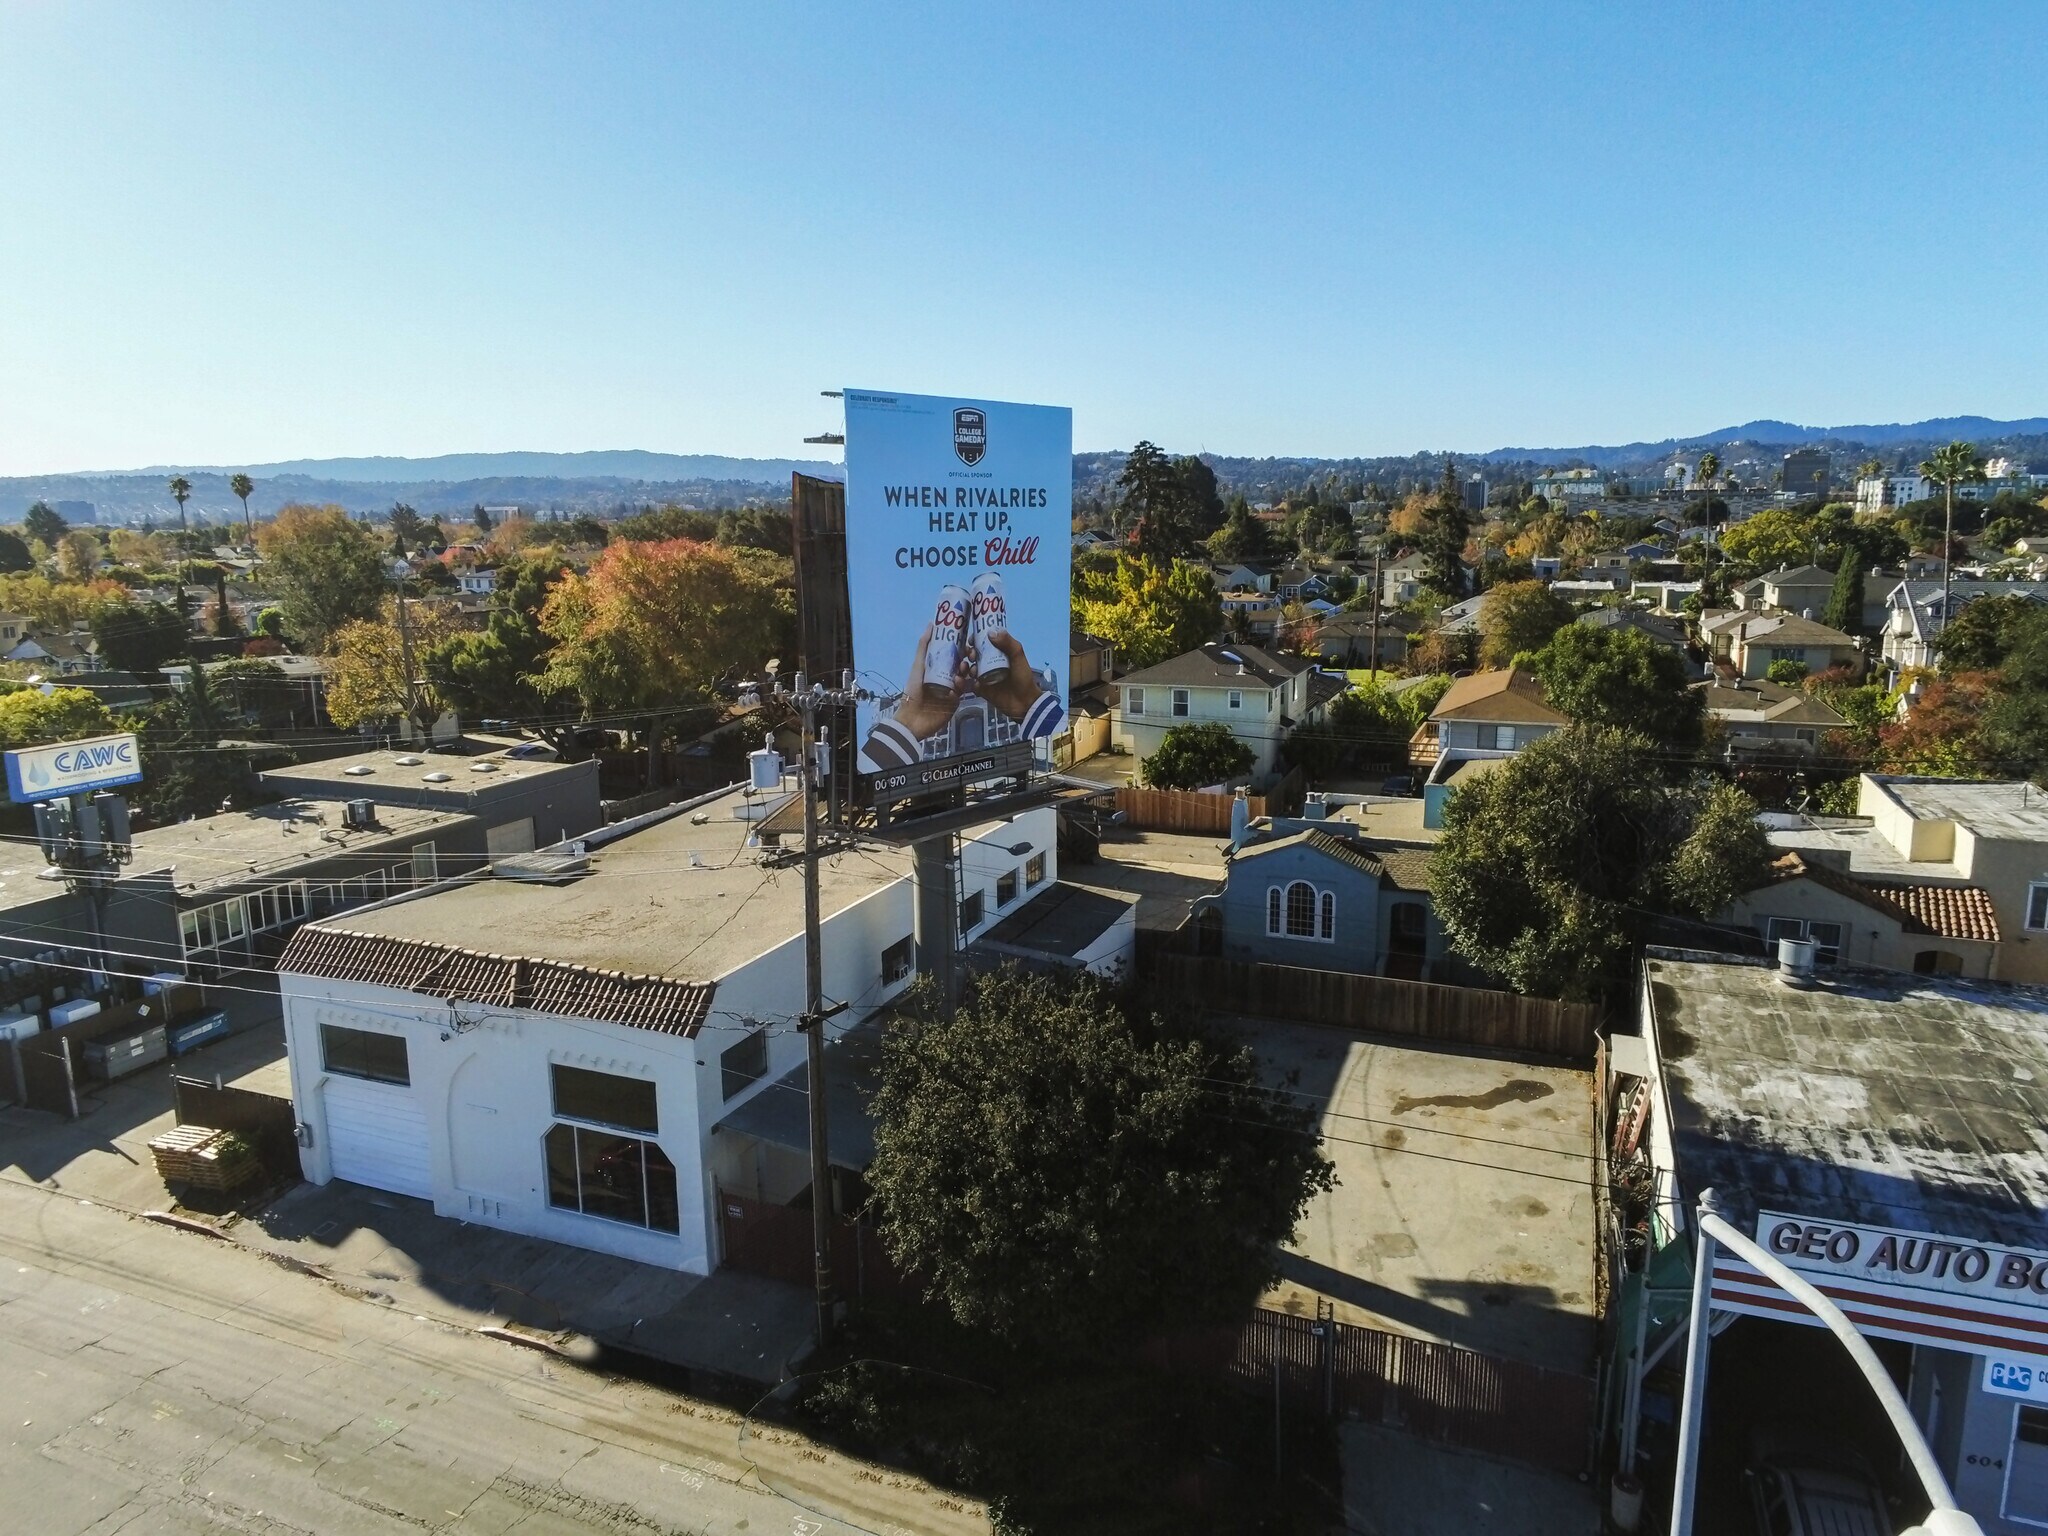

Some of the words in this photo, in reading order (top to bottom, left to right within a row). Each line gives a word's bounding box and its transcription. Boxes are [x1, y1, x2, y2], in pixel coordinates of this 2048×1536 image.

[961, 414, 979, 422] ESPN
[954, 434, 986, 444] GAMEDAY
[958, 427, 982, 436] COLLEGE
[884, 485, 947, 508] WHEN
[955, 487, 1047, 508] RIVALRIES
[929, 511, 978, 532] HEAT
[985, 511, 1012, 536] UP,
[895, 545, 978, 569] CHOOSE
[984, 535, 1040, 567] Chill
[55, 743, 131, 773] CAWC
[1768, 1222, 1860, 1263] GEO
[1866, 1236, 1990, 1284] AUTO
[1992, 1366, 2031, 1386] PPG
[1966, 1454, 2004, 1470] 604
